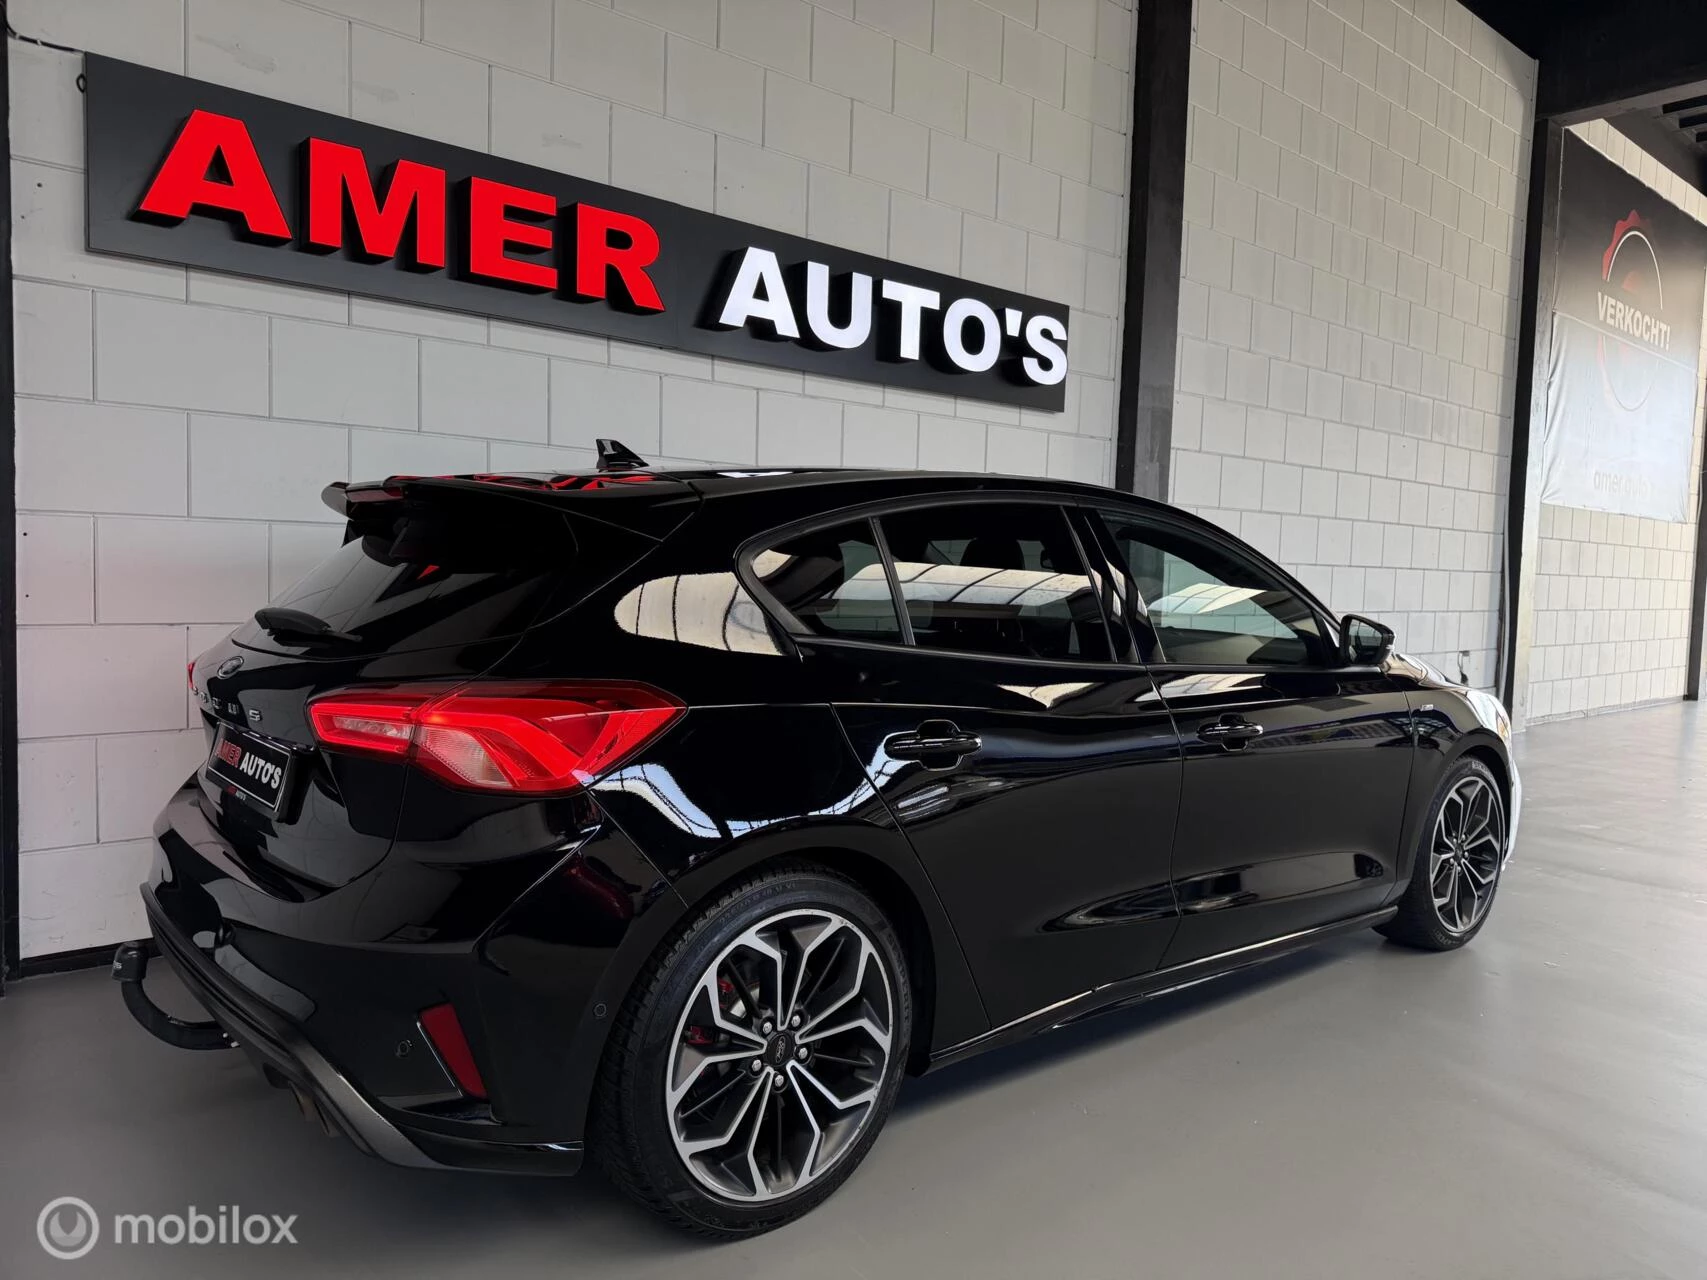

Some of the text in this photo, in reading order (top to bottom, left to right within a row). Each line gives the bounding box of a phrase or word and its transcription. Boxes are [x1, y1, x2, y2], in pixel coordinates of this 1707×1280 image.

[138, 108, 1069, 386] AMER AUTO'S
[1597, 291, 1671, 351] VERKOCHT!
[239, 751, 282, 790] AUTO'S
